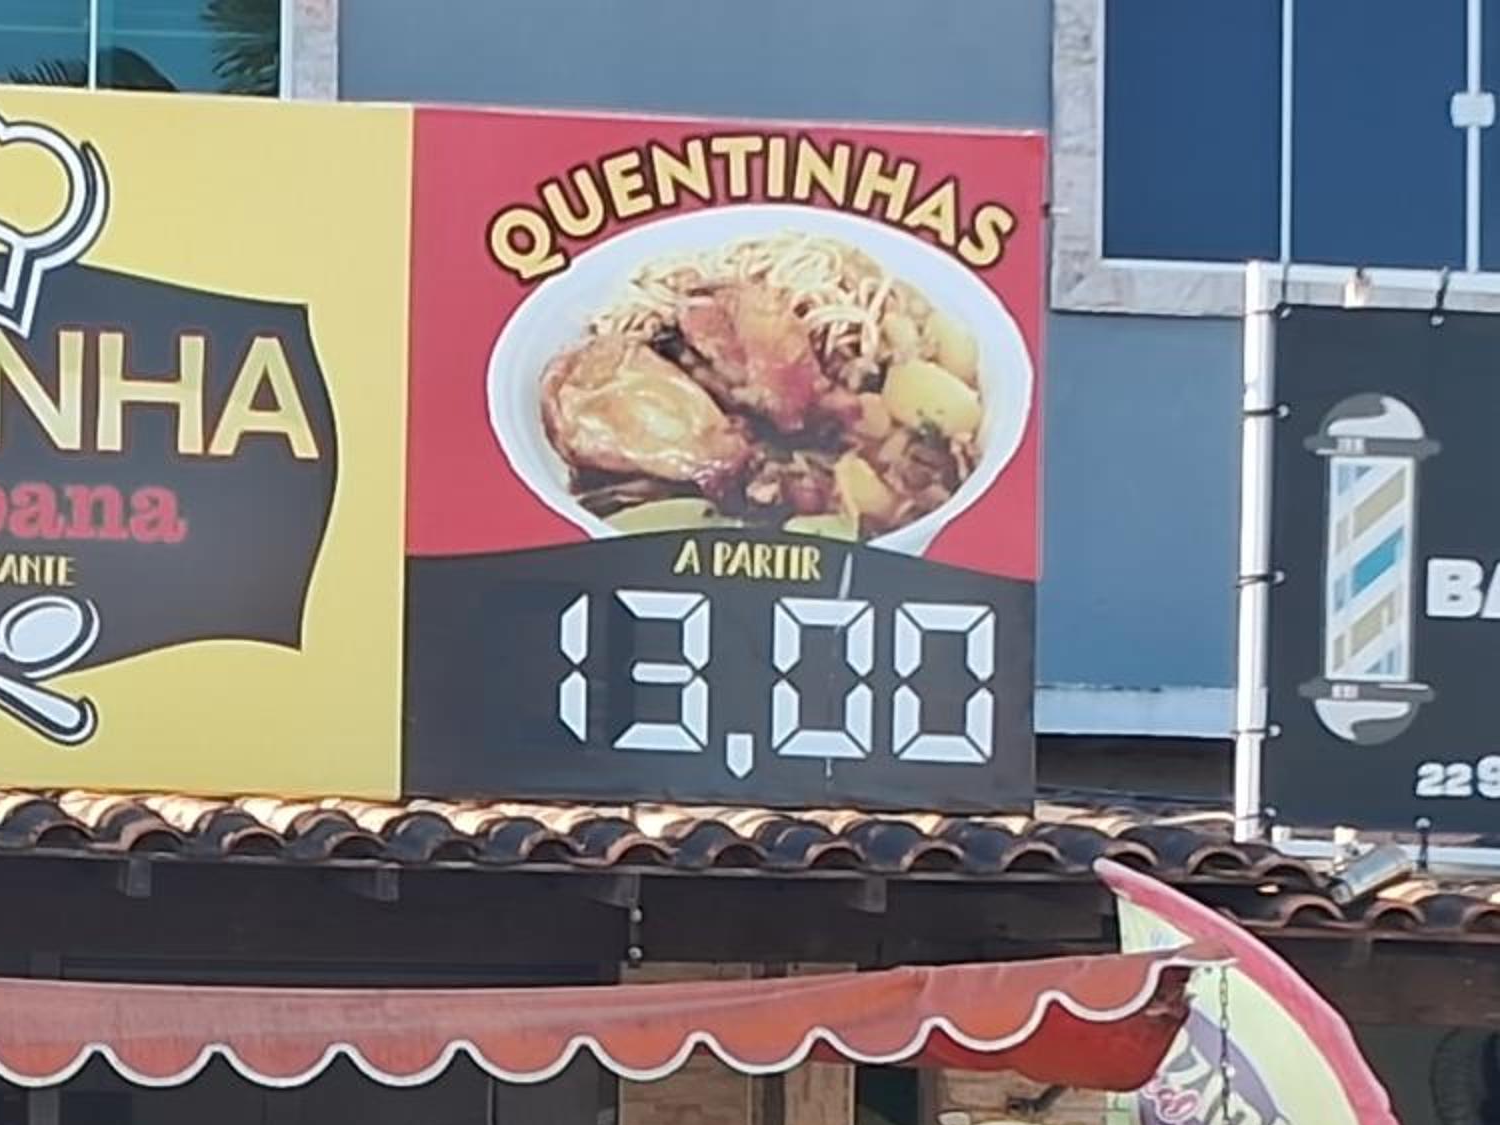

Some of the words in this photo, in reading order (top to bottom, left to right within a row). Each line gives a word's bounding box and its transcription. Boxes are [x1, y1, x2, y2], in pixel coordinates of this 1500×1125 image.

[487, 134, 1015, 279] QUENTINHAS
[672, 538, 701, 575] A
[712, 540, 821, 582] PARTIR
[556, 588, 997, 778] 13,00
